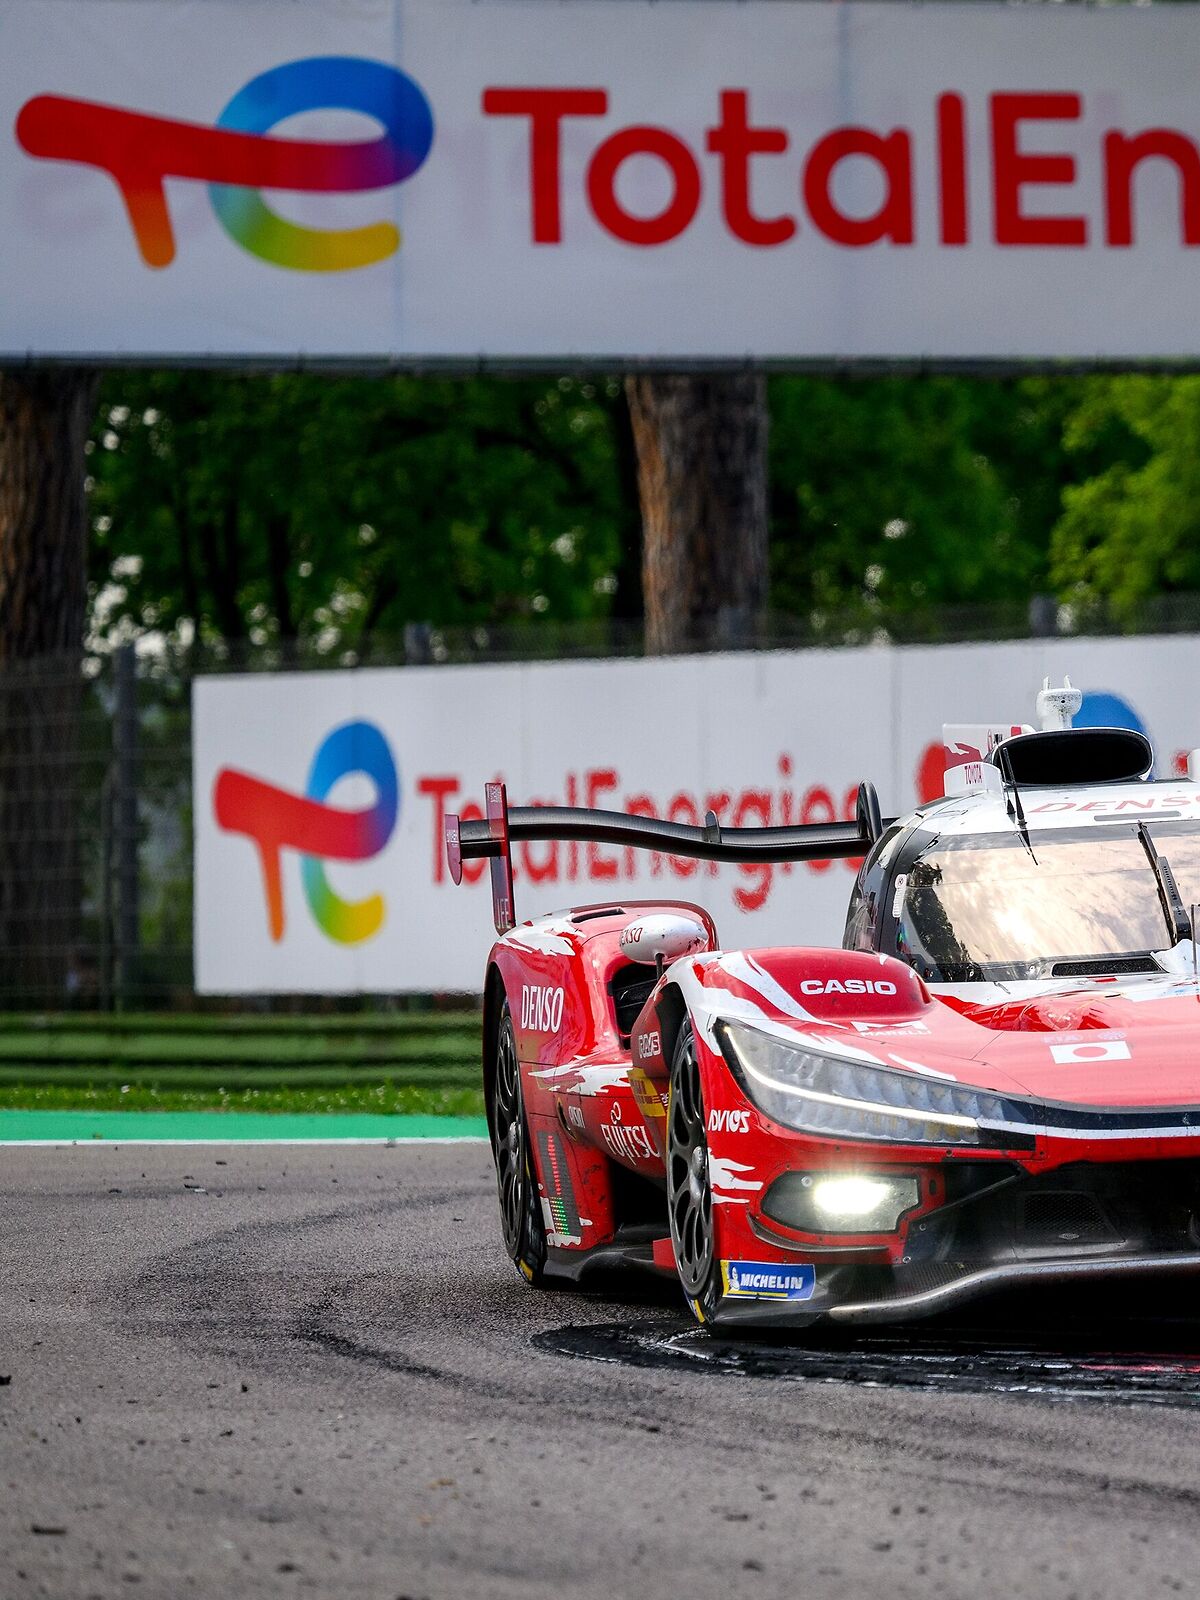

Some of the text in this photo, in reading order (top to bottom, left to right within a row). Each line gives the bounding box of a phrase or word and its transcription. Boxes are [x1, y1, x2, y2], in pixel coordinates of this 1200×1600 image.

[800, 979, 897, 995] CASIO
[521, 984, 565, 1033] DENSO
[740, 1273, 804, 1290] MICHELIN
